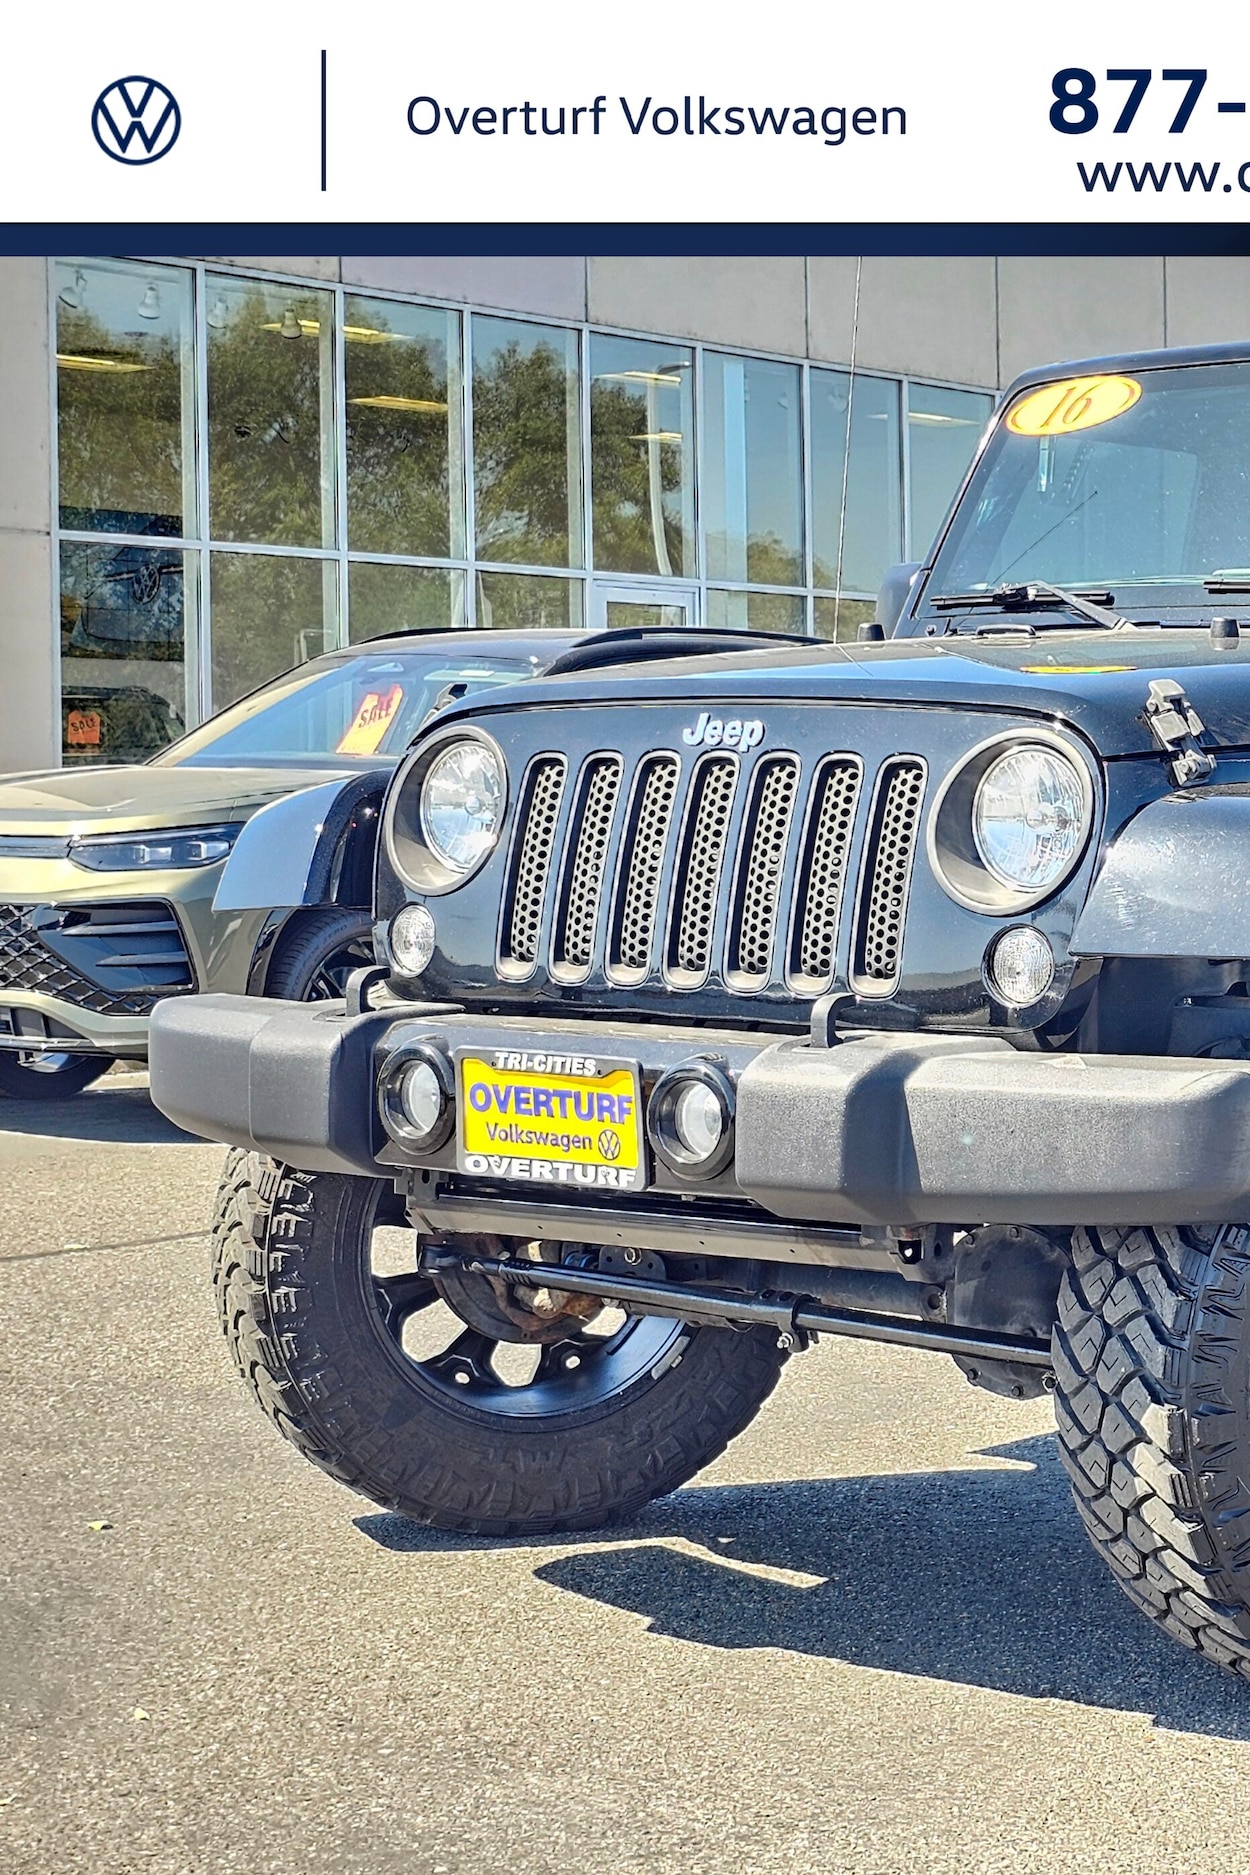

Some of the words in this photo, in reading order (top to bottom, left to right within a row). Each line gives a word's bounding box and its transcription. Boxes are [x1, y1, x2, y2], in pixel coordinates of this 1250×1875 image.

[1038, 382, 1103, 428] 16
[71, 717, 97, 732] SALE
[358, 696, 394, 729] SALE
[682, 712, 765, 753] Jeep
[495, 1051, 597, 1076] TRI-CITIES
[469, 1082, 633, 1124] OVERTURF
[486, 1121, 593, 1152] Volkswagen
[464, 1154, 637, 1188] OVERTURF
